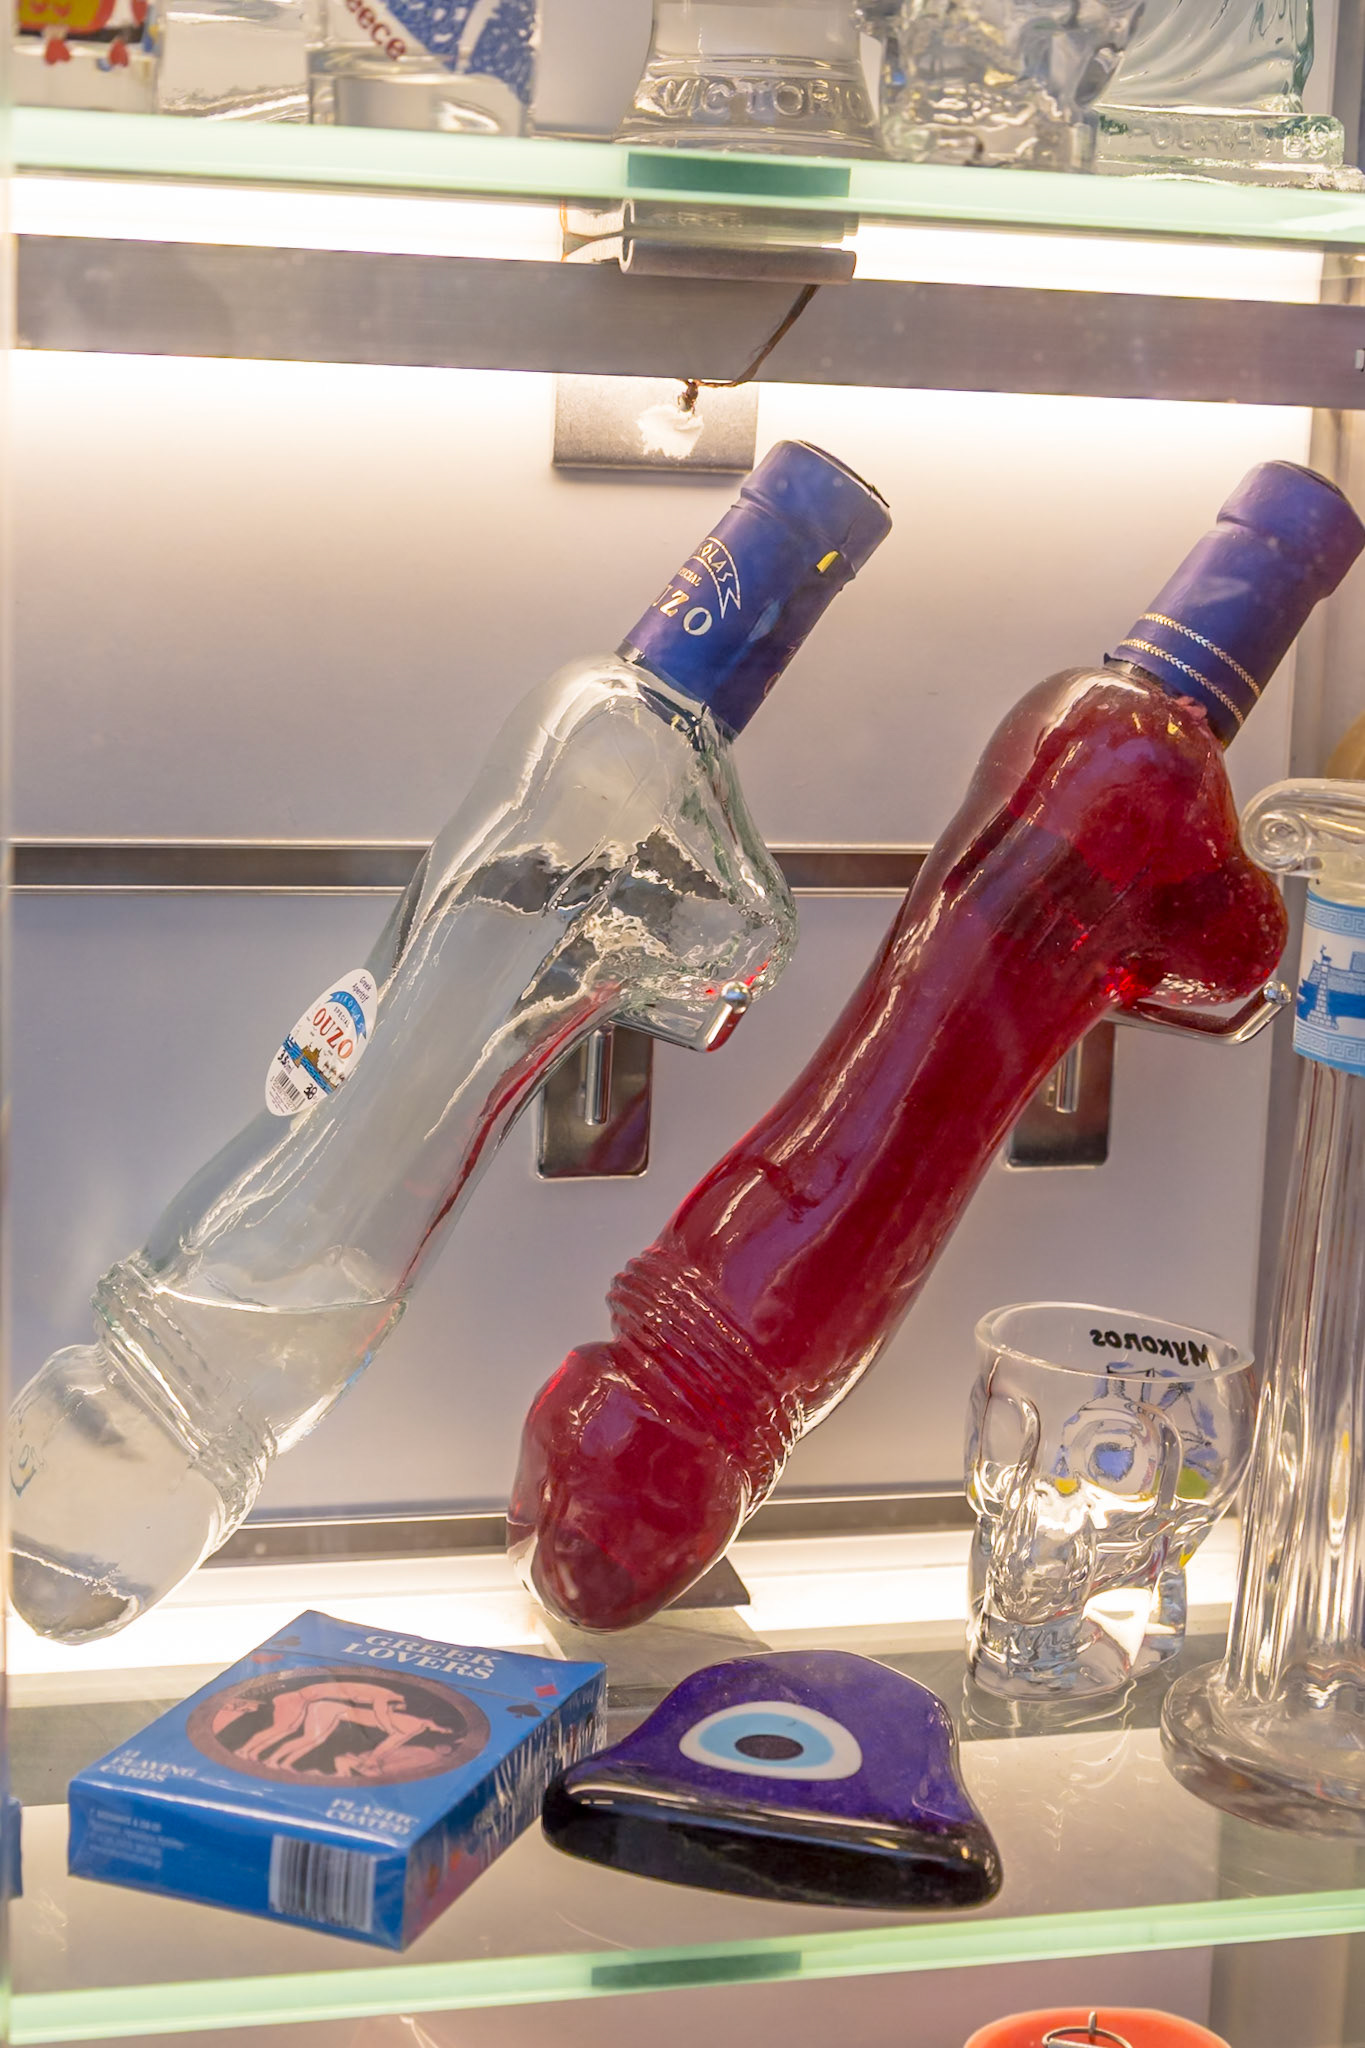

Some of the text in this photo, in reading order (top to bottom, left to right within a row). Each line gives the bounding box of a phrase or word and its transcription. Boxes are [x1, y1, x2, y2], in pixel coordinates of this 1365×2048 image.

[699, 542, 733, 582] OLAS
[312, 1007, 354, 1060] OUZO
[341, 1642, 495, 1681] LOVERS
[364, 1635, 503, 1669] GREEK
[99, 1764, 167, 1783] CARDS
[110, 1756, 198, 1778] PLAYING
[325, 1808, 411, 1836] COATED
[331, 1798, 421, 1825] PLASTIC
